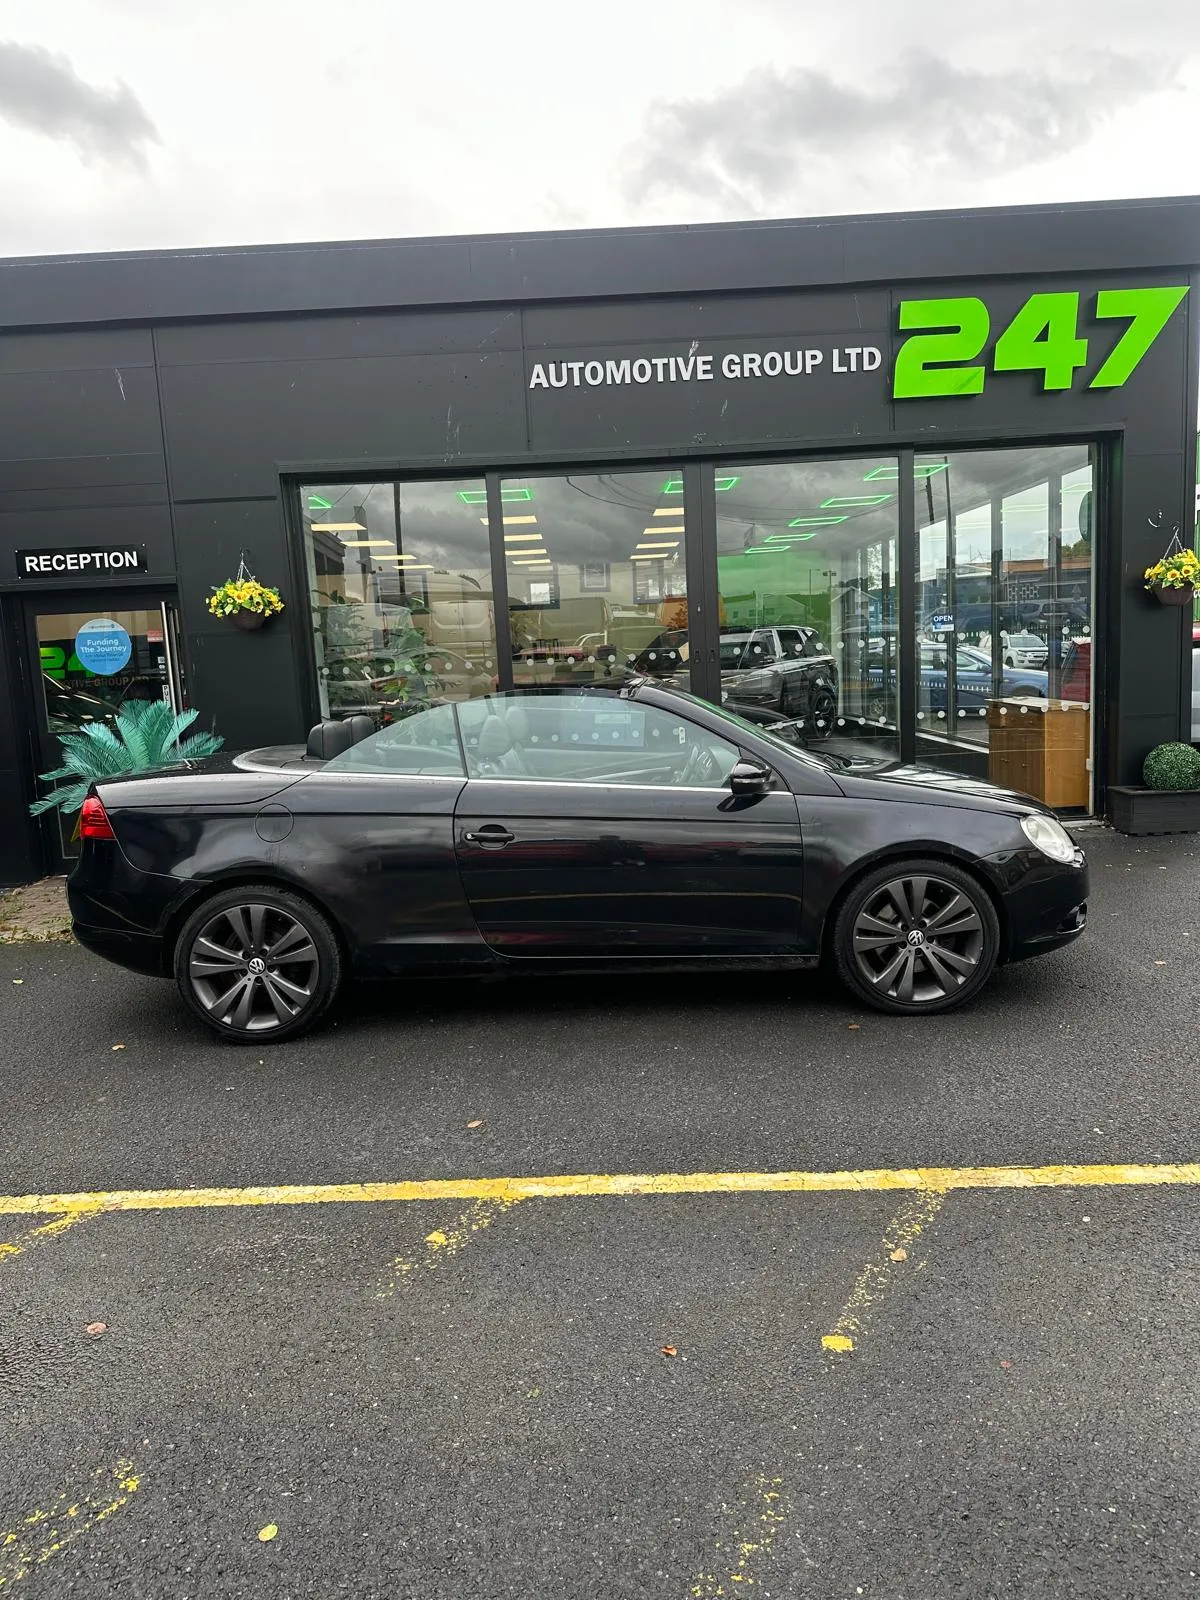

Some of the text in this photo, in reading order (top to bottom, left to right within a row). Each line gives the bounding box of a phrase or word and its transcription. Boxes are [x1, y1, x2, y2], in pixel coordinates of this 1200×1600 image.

[893, 286, 1190, 399] 247
[528, 346, 882, 390] AUTOMOTIVE GROUP LTD
[24, 551, 138, 572] RECEPTION
[96, 645, 127, 653] Journey
